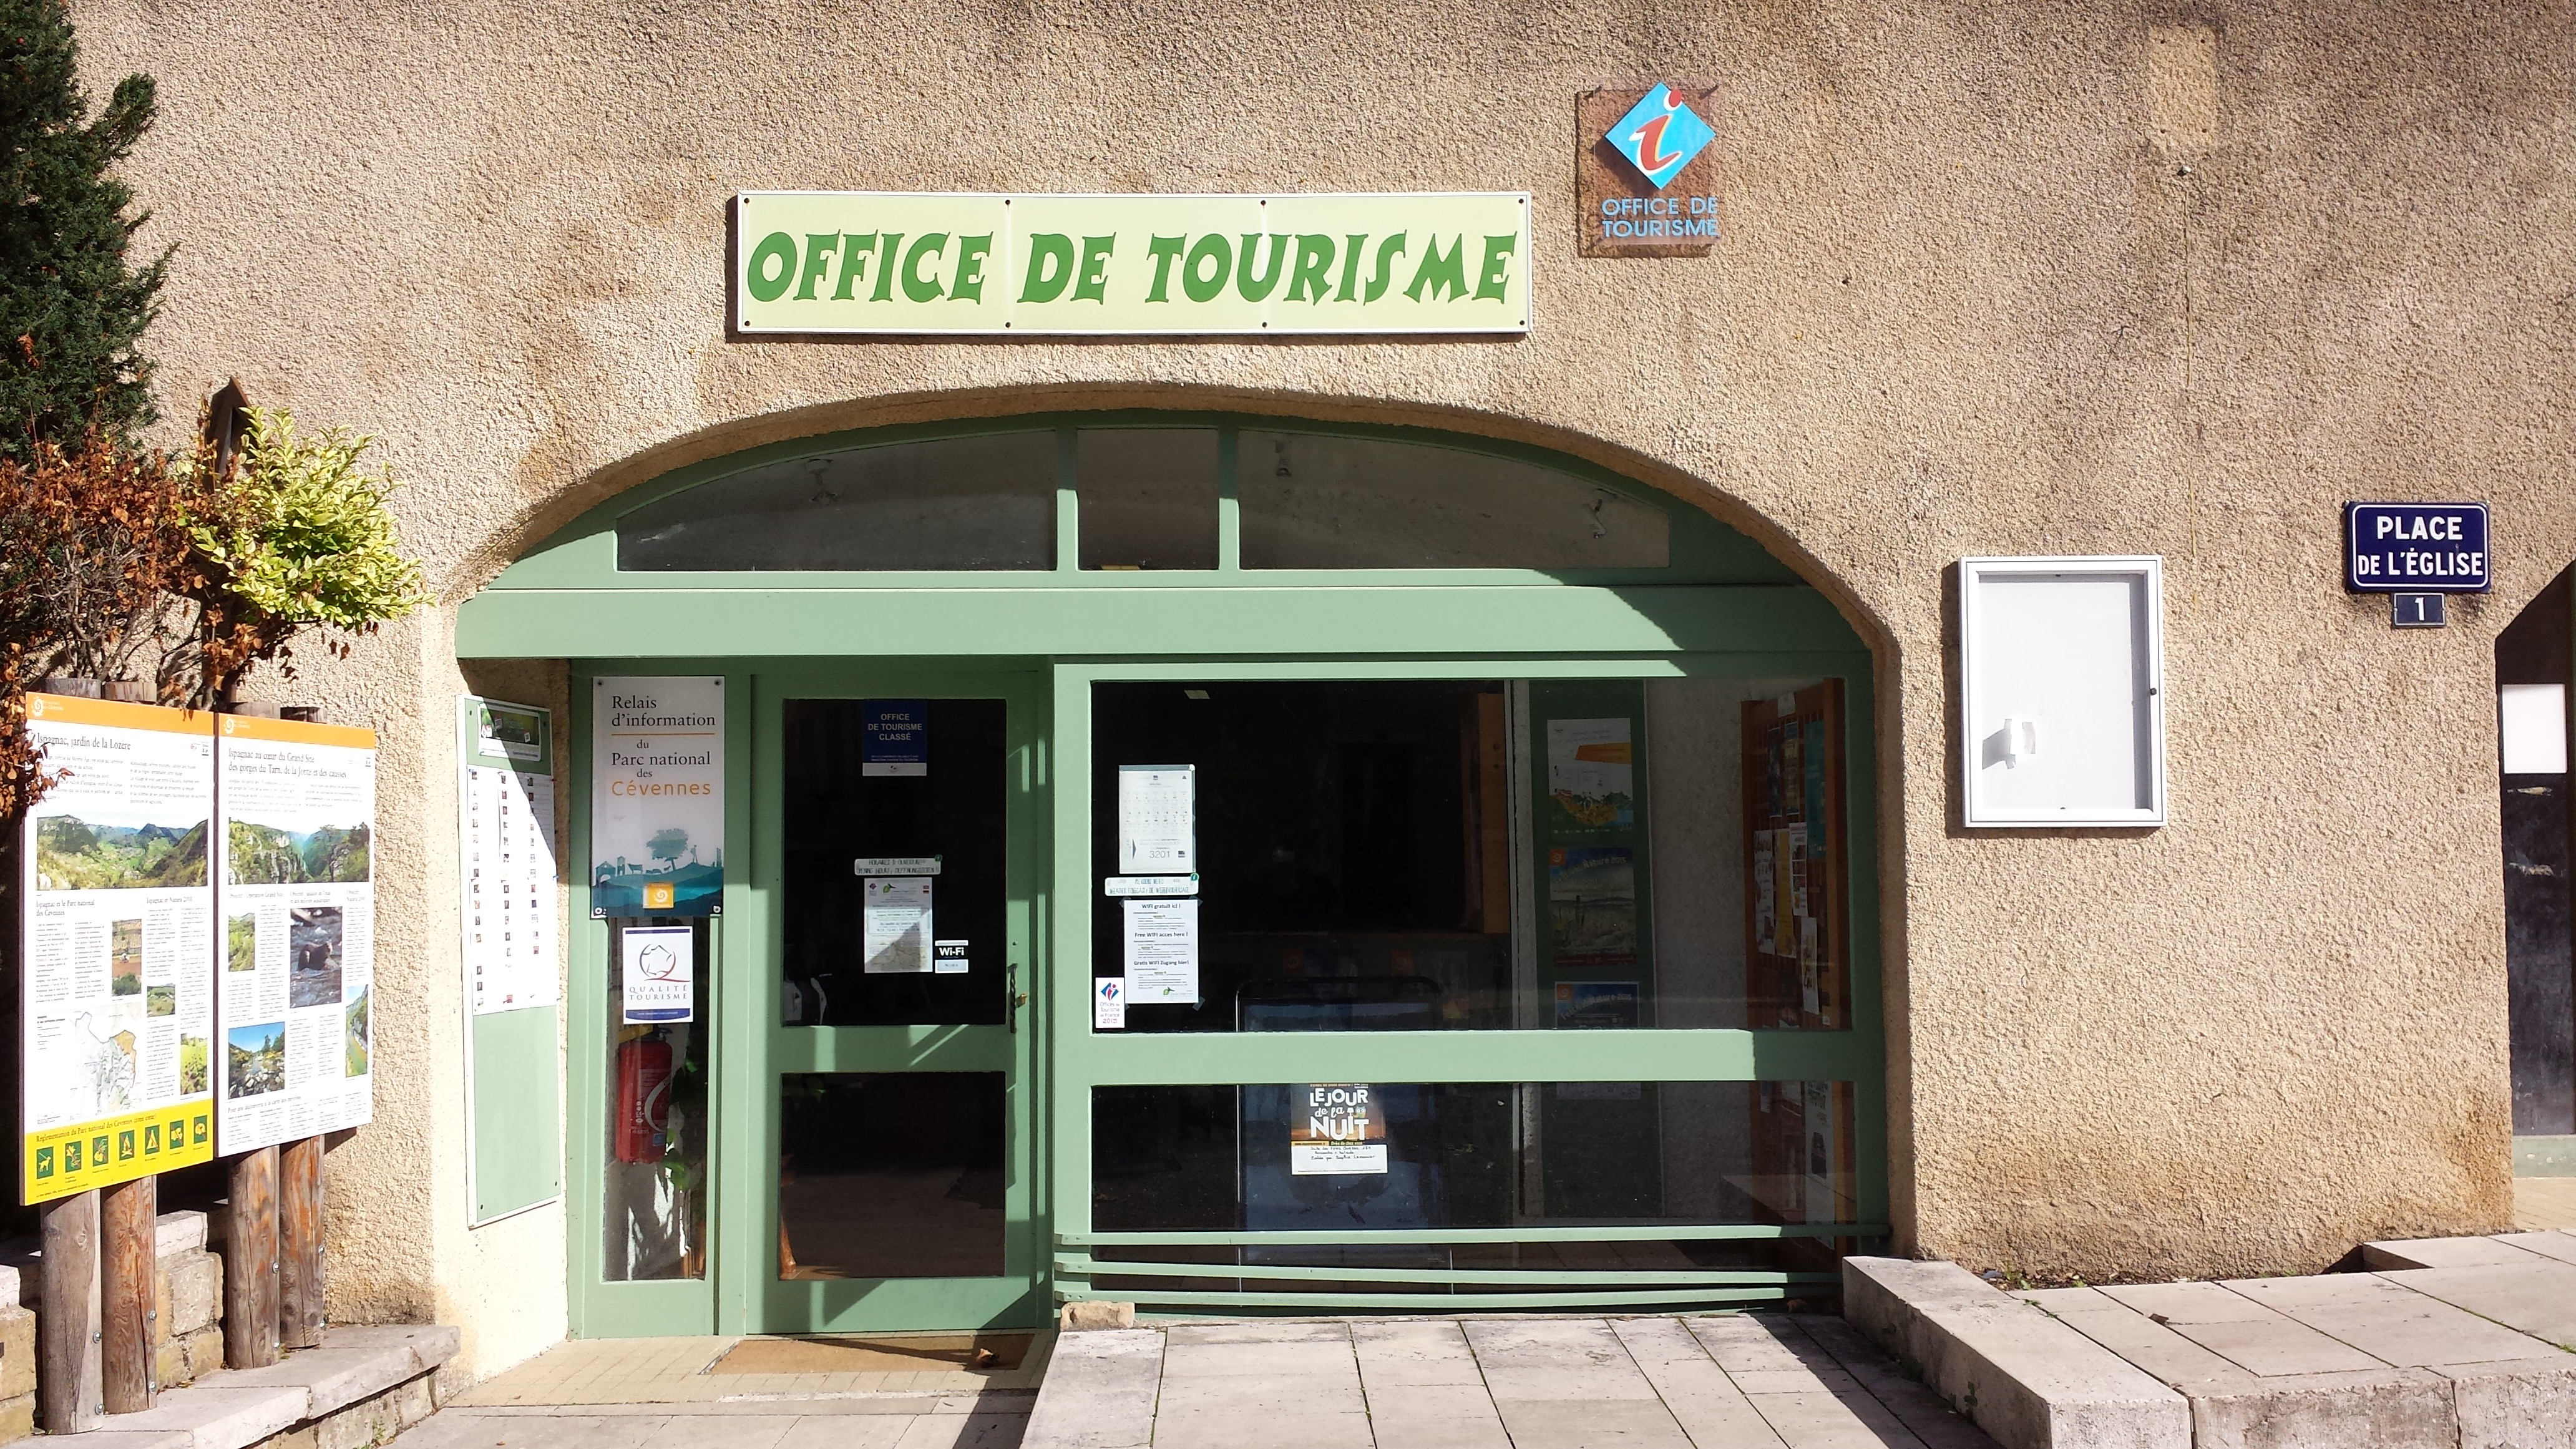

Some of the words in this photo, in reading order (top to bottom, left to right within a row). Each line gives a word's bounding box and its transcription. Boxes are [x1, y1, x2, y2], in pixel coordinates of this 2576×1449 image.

[1601, 197, 1679, 216] OFFICE
[1690, 196, 1719, 215] DE
[1601, 218, 1720, 237] TOURISME
[747, 228, 994, 305] OFFICE
[1017, 232, 1117, 305] DE
[1144, 229, 1518, 306] TOURISME
[2376, 515, 2464, 540] PLACE
[2358, 554, 2381, 575] DE
[2388, 547, 2484, 576] L'ÉGLISE
[2414, 597, 2426, 621] 1
[611, 695, 657, 710] Relais
[611, 712, 716, 727] d'information
[880, 713, 910, 721] OFFICE
[867, 723, 879, 731] DE
[881, 723, 923, 731] TOURISME
[879, 731, 912, 741] CLASSÉ
[71, 736, 90, 748] jardin
[92, 736, 100, 748] de
[102, 737, 108, 748] la
[110, 738, 131, 750] Lozère
[636, 739, 650, 749] du
[278, 751, 286, 761] du
[287, 753, 304, 763] Grand
[611, 752, 645, 766] Parc
[649, 751, 711, 766] national
[228, 761, 238, 771] des
[240, 764, 257, 774] gorges
[259, 763, 266, 773] du
[636, 768, 653, 778] des
[611, 779, 711, 796] Cévennes
[1149, 850, 1171, 859] 3201
[1583, 857, 1609, 869] Nature
[939, 947, 965, 957] Wi-Fi
[629, 984, 688, 994] QUALITÉ
[629, 993, 688, 1001] TOURISME
[1310, 1088, 1325, 1107] LE
[1324, 1088, 1368, 1106] JOUR
[1314, 1106, 1329, 1118] de
[1330, 1106, 1345, 1118] la
[1310, 1115, 1369, 1141] NUIT
